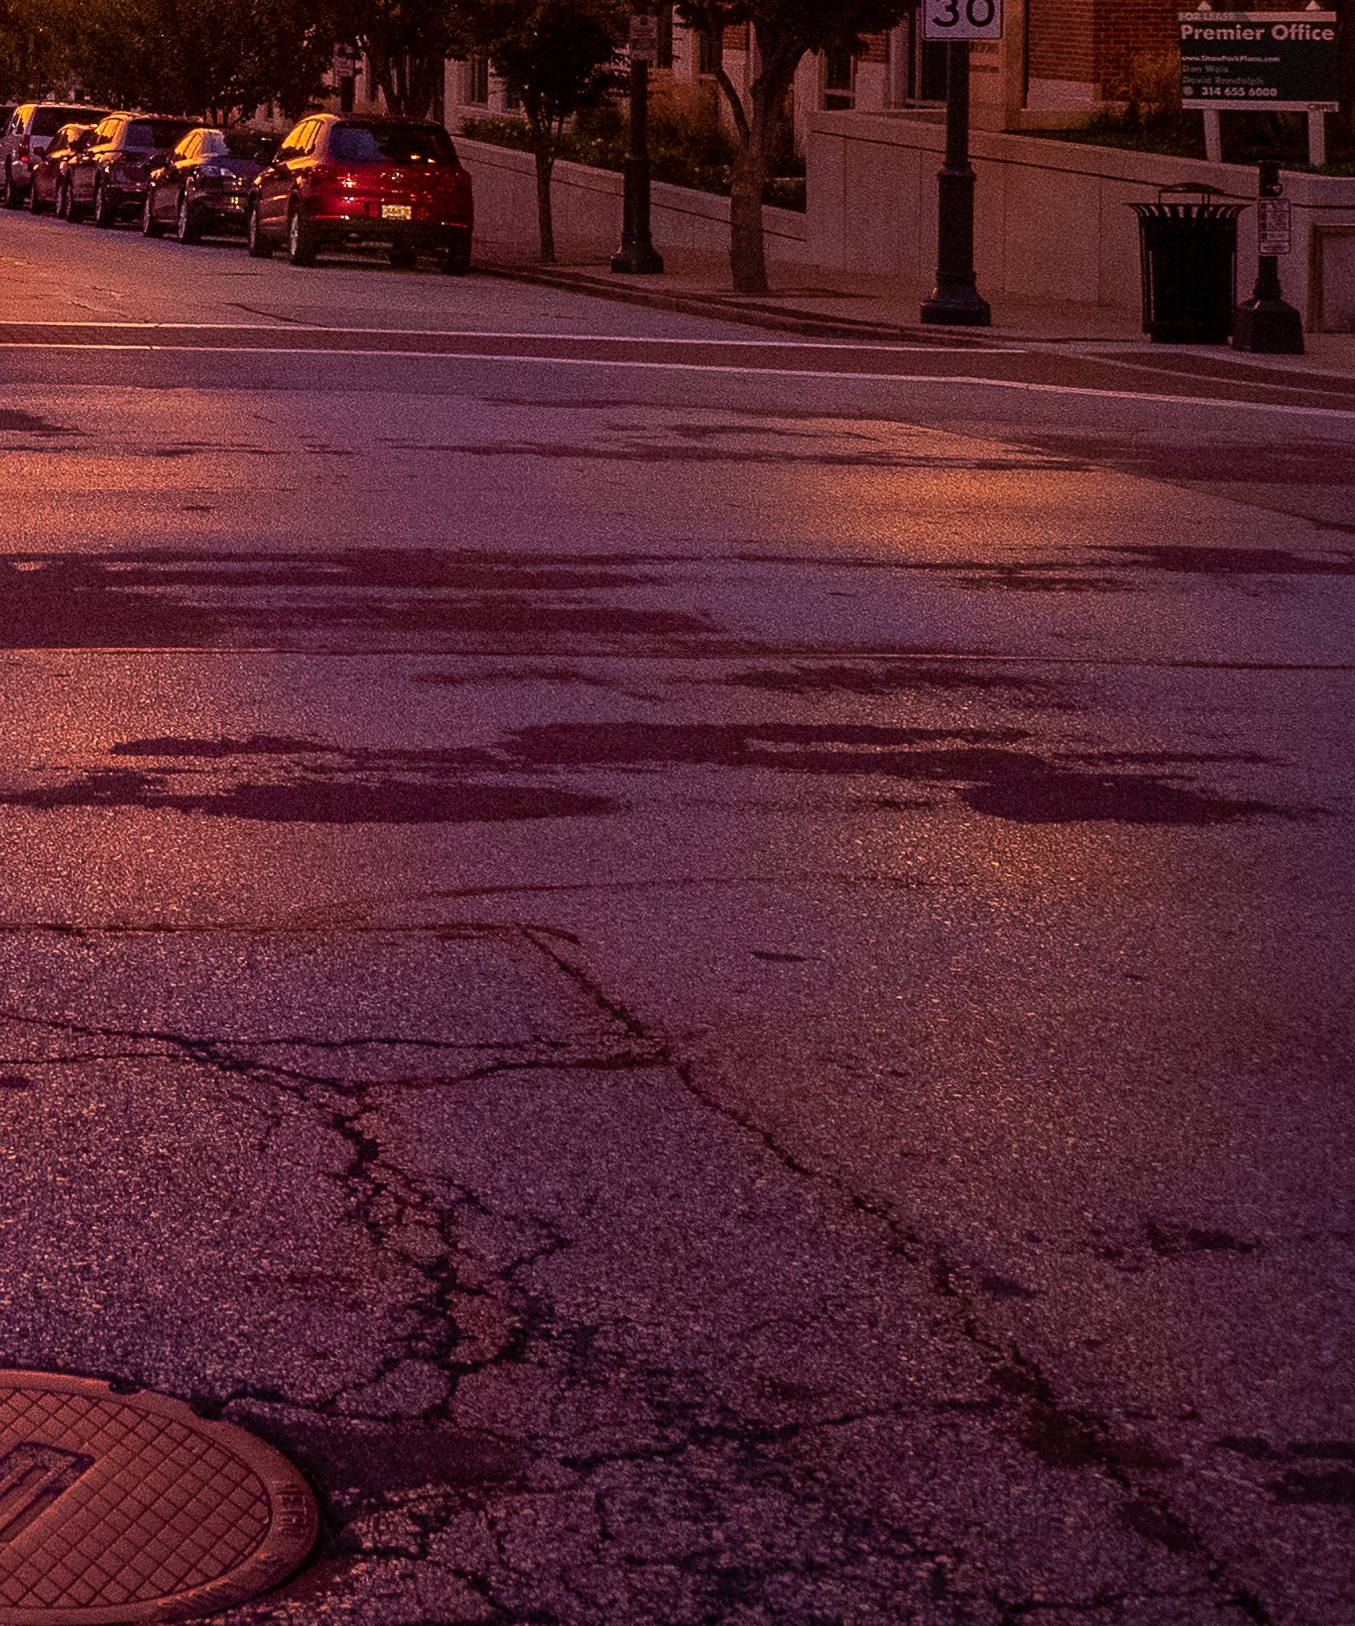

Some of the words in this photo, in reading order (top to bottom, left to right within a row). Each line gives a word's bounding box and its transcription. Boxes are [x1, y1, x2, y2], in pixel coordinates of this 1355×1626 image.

[1180, 23, 1265, 41] Premier
[1271, 23, 1335, 41] Office
[1201, 86, 1221, 96] 314
